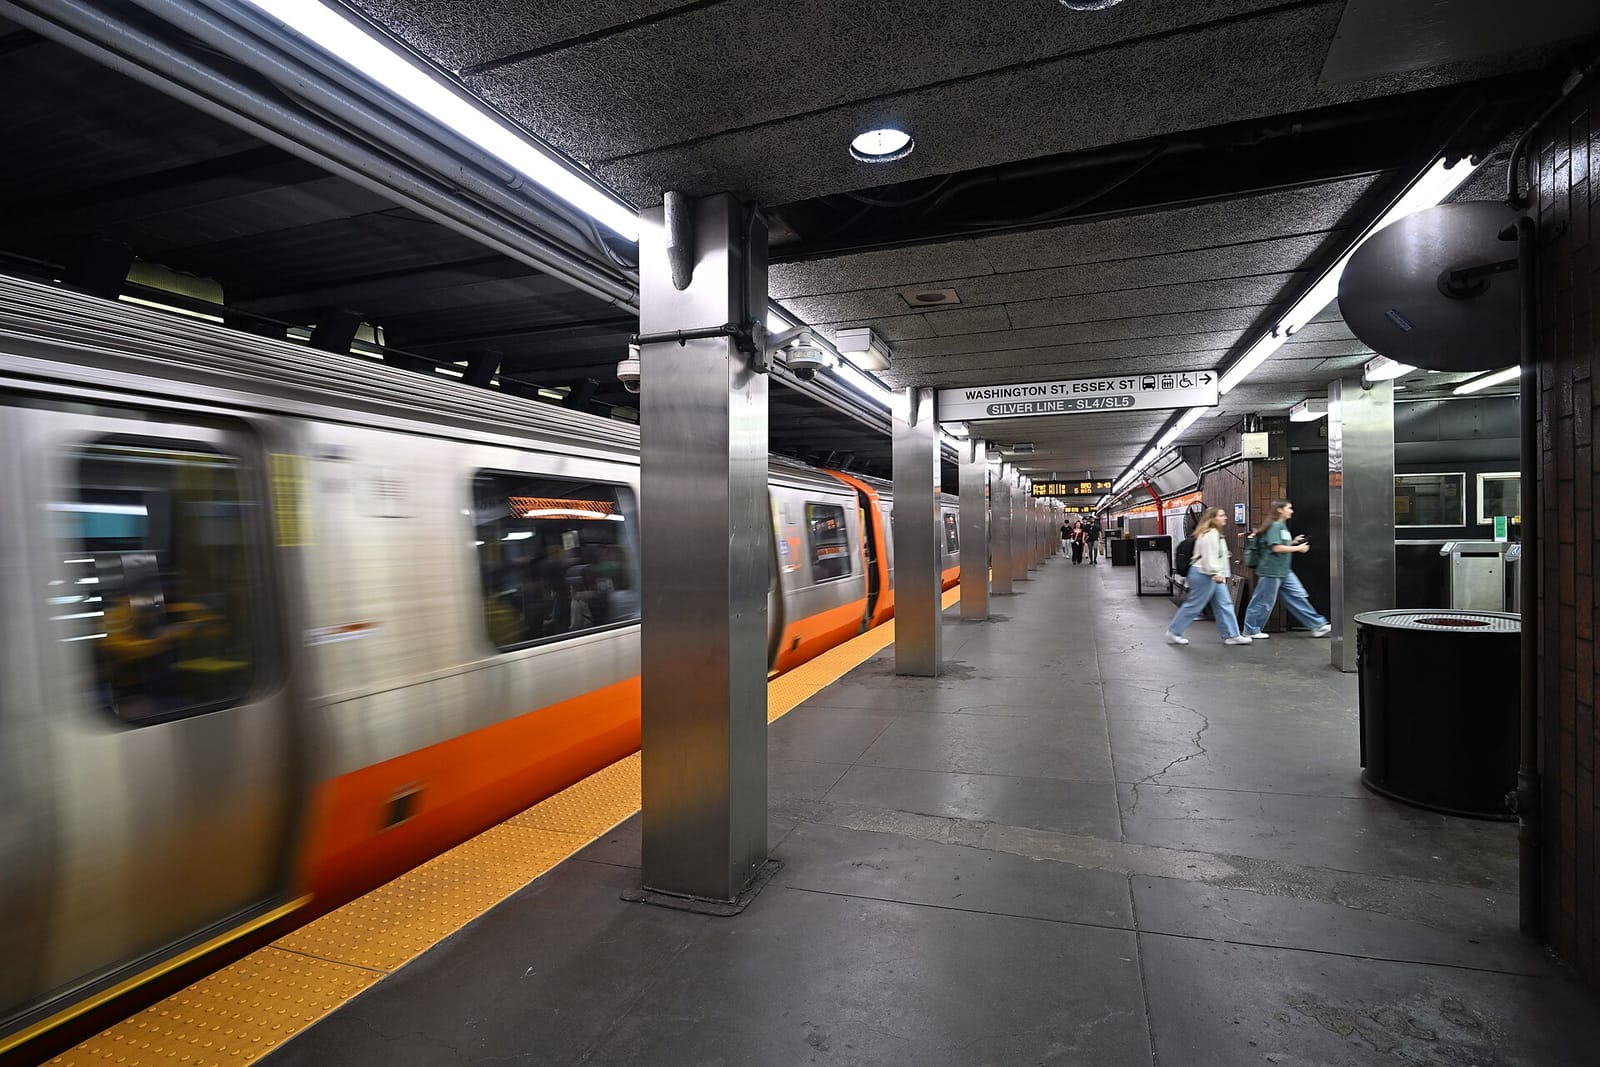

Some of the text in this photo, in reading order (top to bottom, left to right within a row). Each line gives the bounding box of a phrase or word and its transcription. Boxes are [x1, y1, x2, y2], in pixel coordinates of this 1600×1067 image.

[965, 379, 1135, 400] WASHINGTON ST, ESSEX ST
[991, 403, 1033, 415] SILVER
[1036, 401, 1064, 412] LINE
[1076, 397, 1129, 410] SL4/SL5
